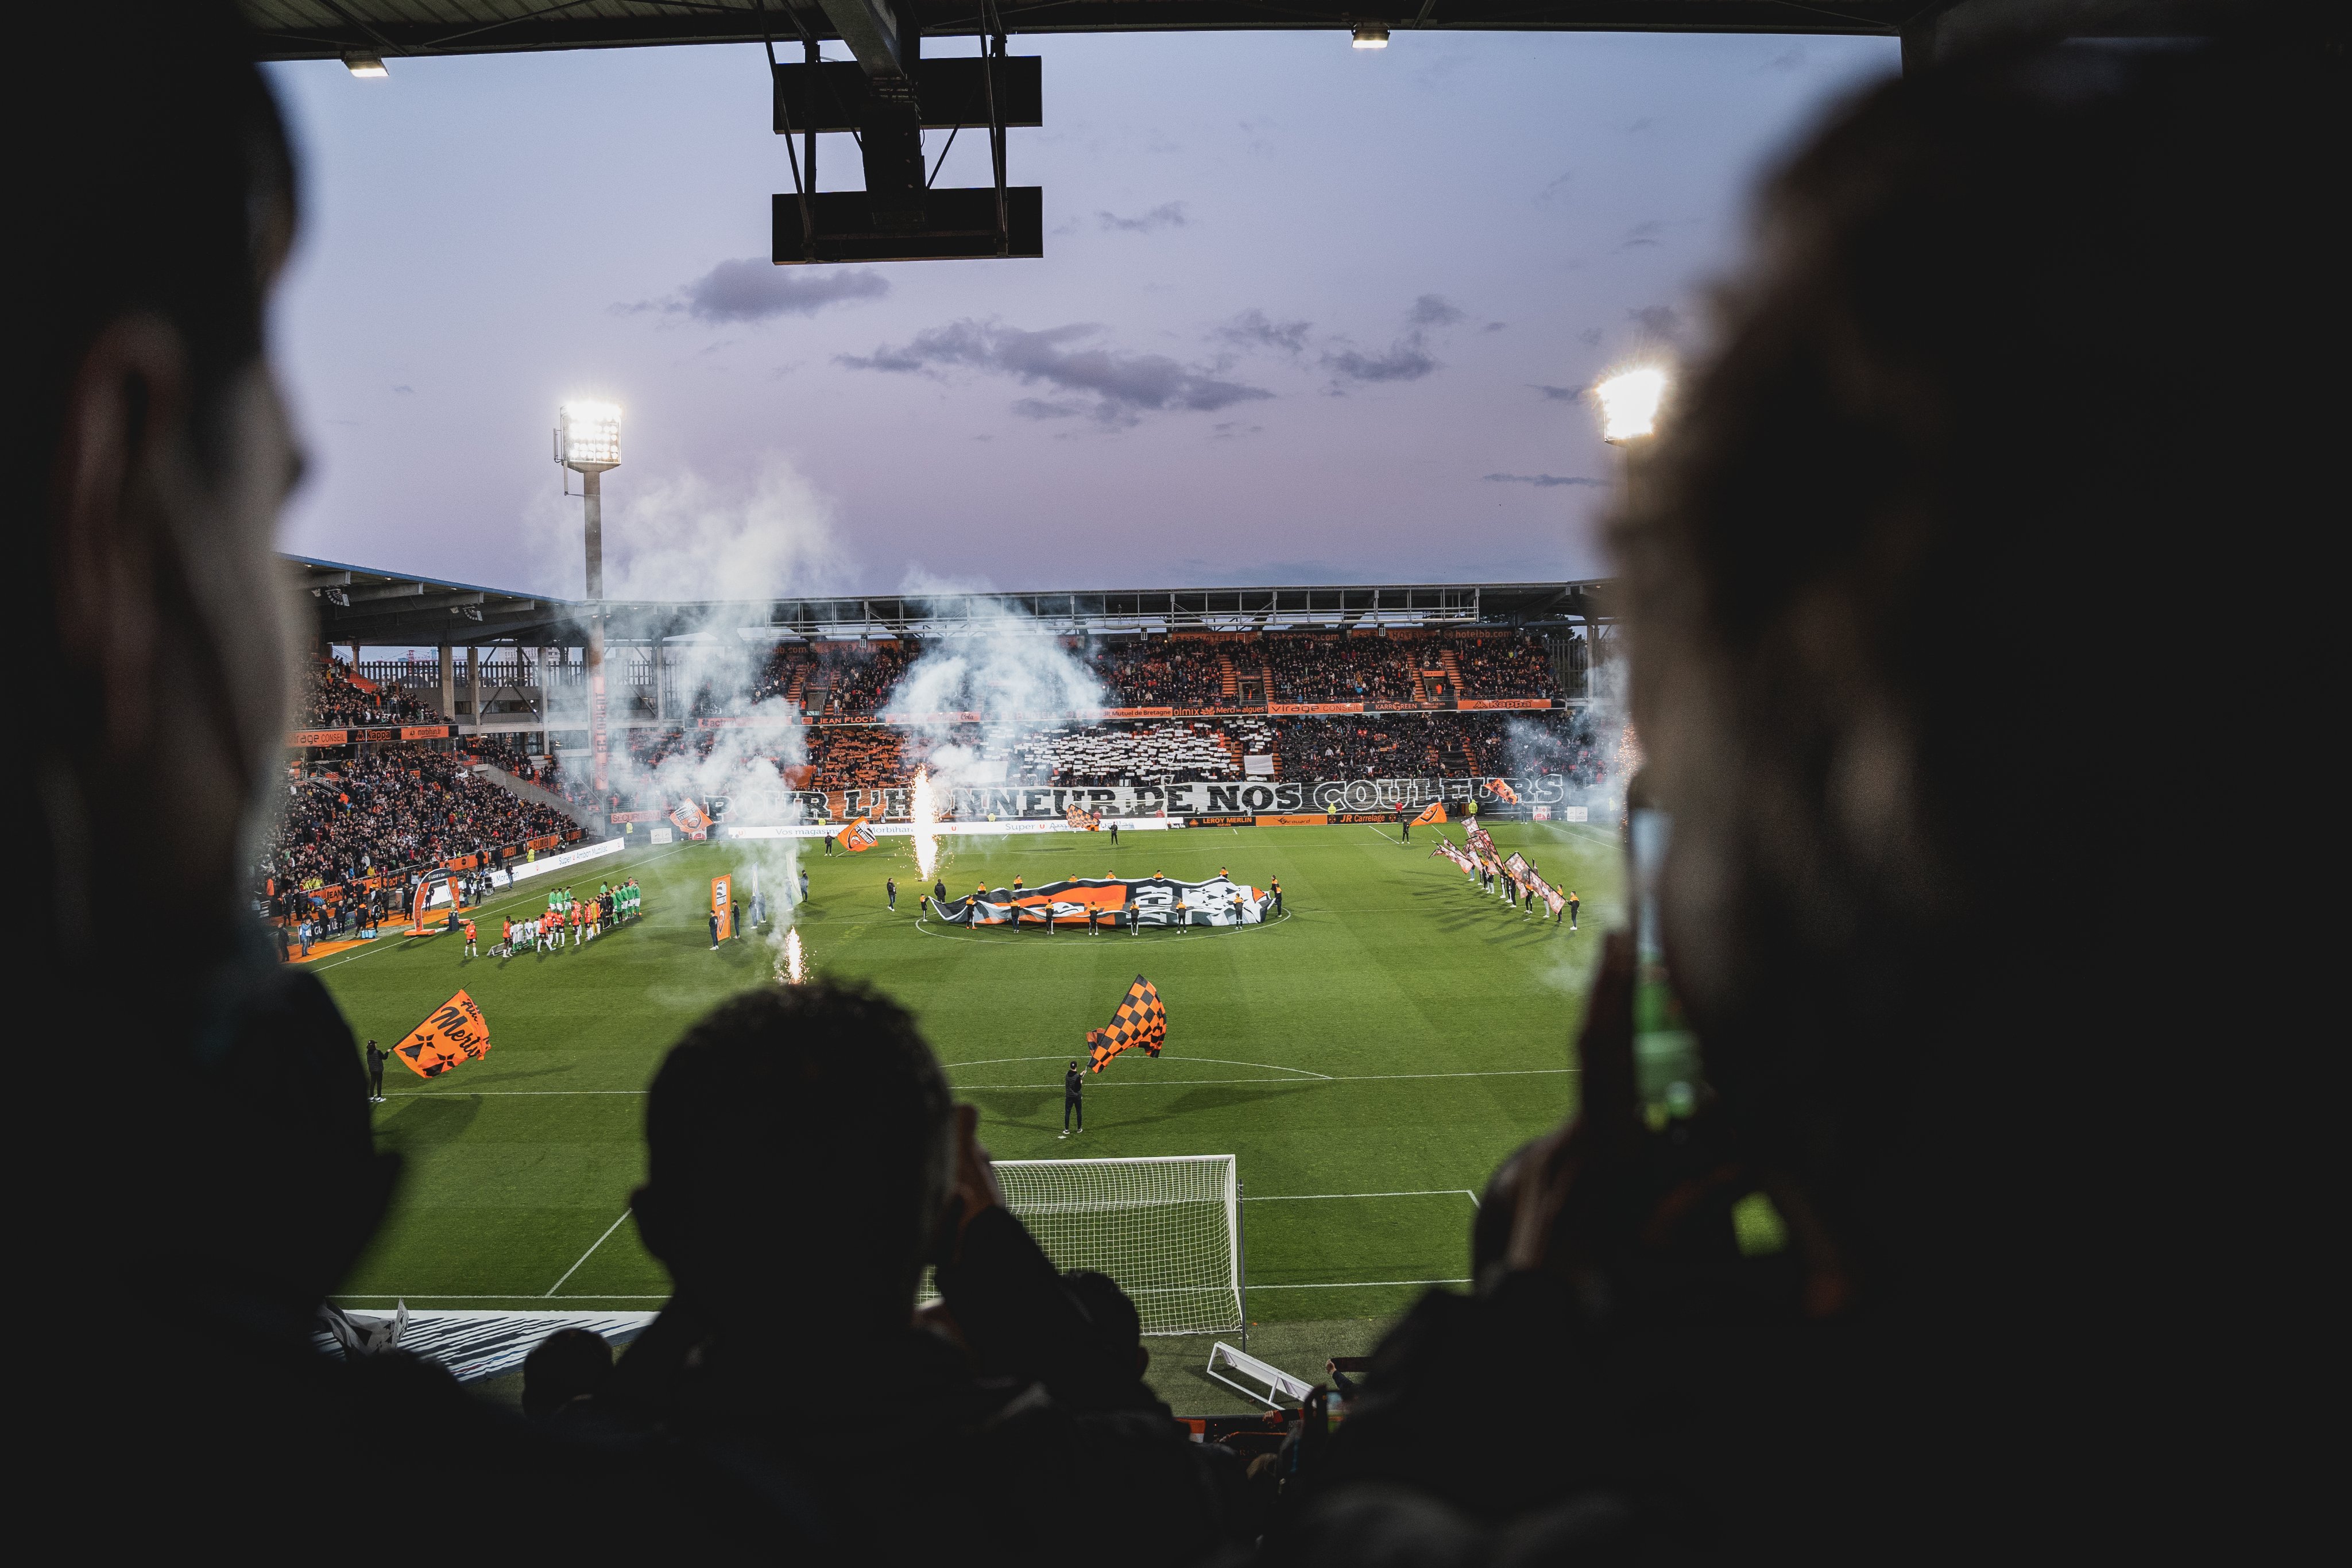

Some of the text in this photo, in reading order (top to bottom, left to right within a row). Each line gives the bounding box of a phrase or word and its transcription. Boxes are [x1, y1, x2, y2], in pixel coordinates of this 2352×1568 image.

[1271, 704, 1320, 713] virage
[1489, 700, 1531, 708] Kappa
[1174, 707, 1199, 716] olmix
[322, 733, 345, 742] CONSEIL
[366, 730, 391, 741] Kappa
[703, 790, 832, 824] POUR
[1133, 784, 1193, 816] DE
[1206, 782, 1303, 812] NOS
[1340, 814, 1385, 823] JR Carrelage
[776, 828, 793, 836] Vos
[795, 827, 840, 838] magasins
[1005, 823, 1035, 832] Super
[533, 837, 551, 851] FC LORIENT
[502, 846, 516, 858] LORIENT
[559, 855, 571, 865] Super
[577, 850, 591, 860] Ambon
[592, 846, 608, 856] Muzillac
